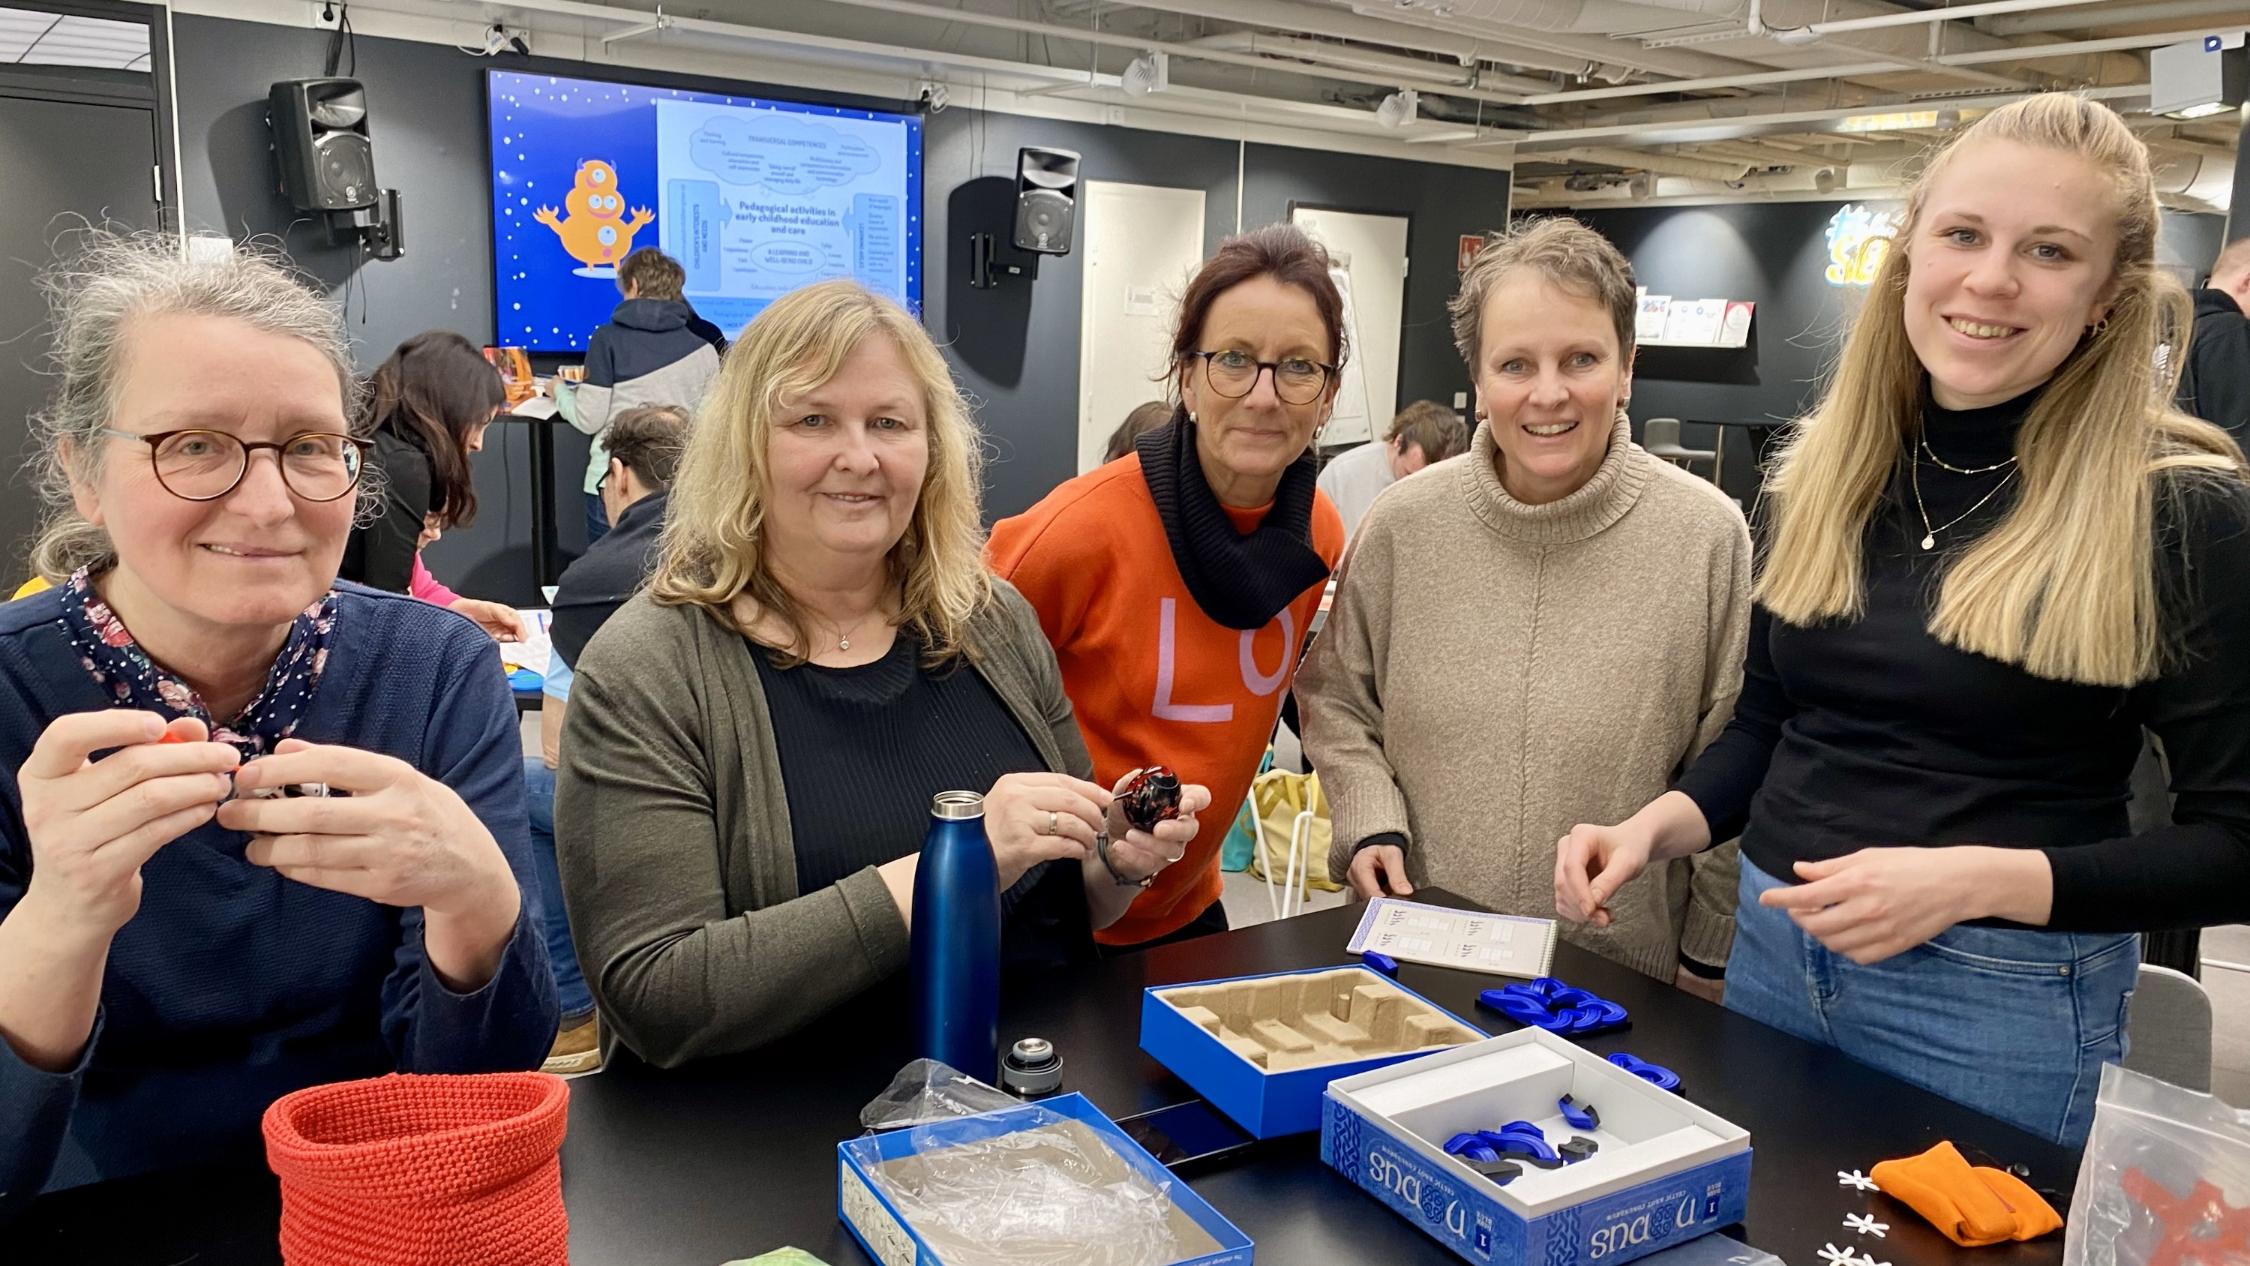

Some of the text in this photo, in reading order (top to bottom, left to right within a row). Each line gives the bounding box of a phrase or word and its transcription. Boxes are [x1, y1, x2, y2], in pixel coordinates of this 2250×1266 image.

[739, 201, 836, 217] Pedagogical activities in
[735, 212, 840, 227] early childhood education
[771, 225, 806, 235] and care
[1709, 1201, 1715, 1213] 1
[1480, 1233, 1487, 1247] 1
